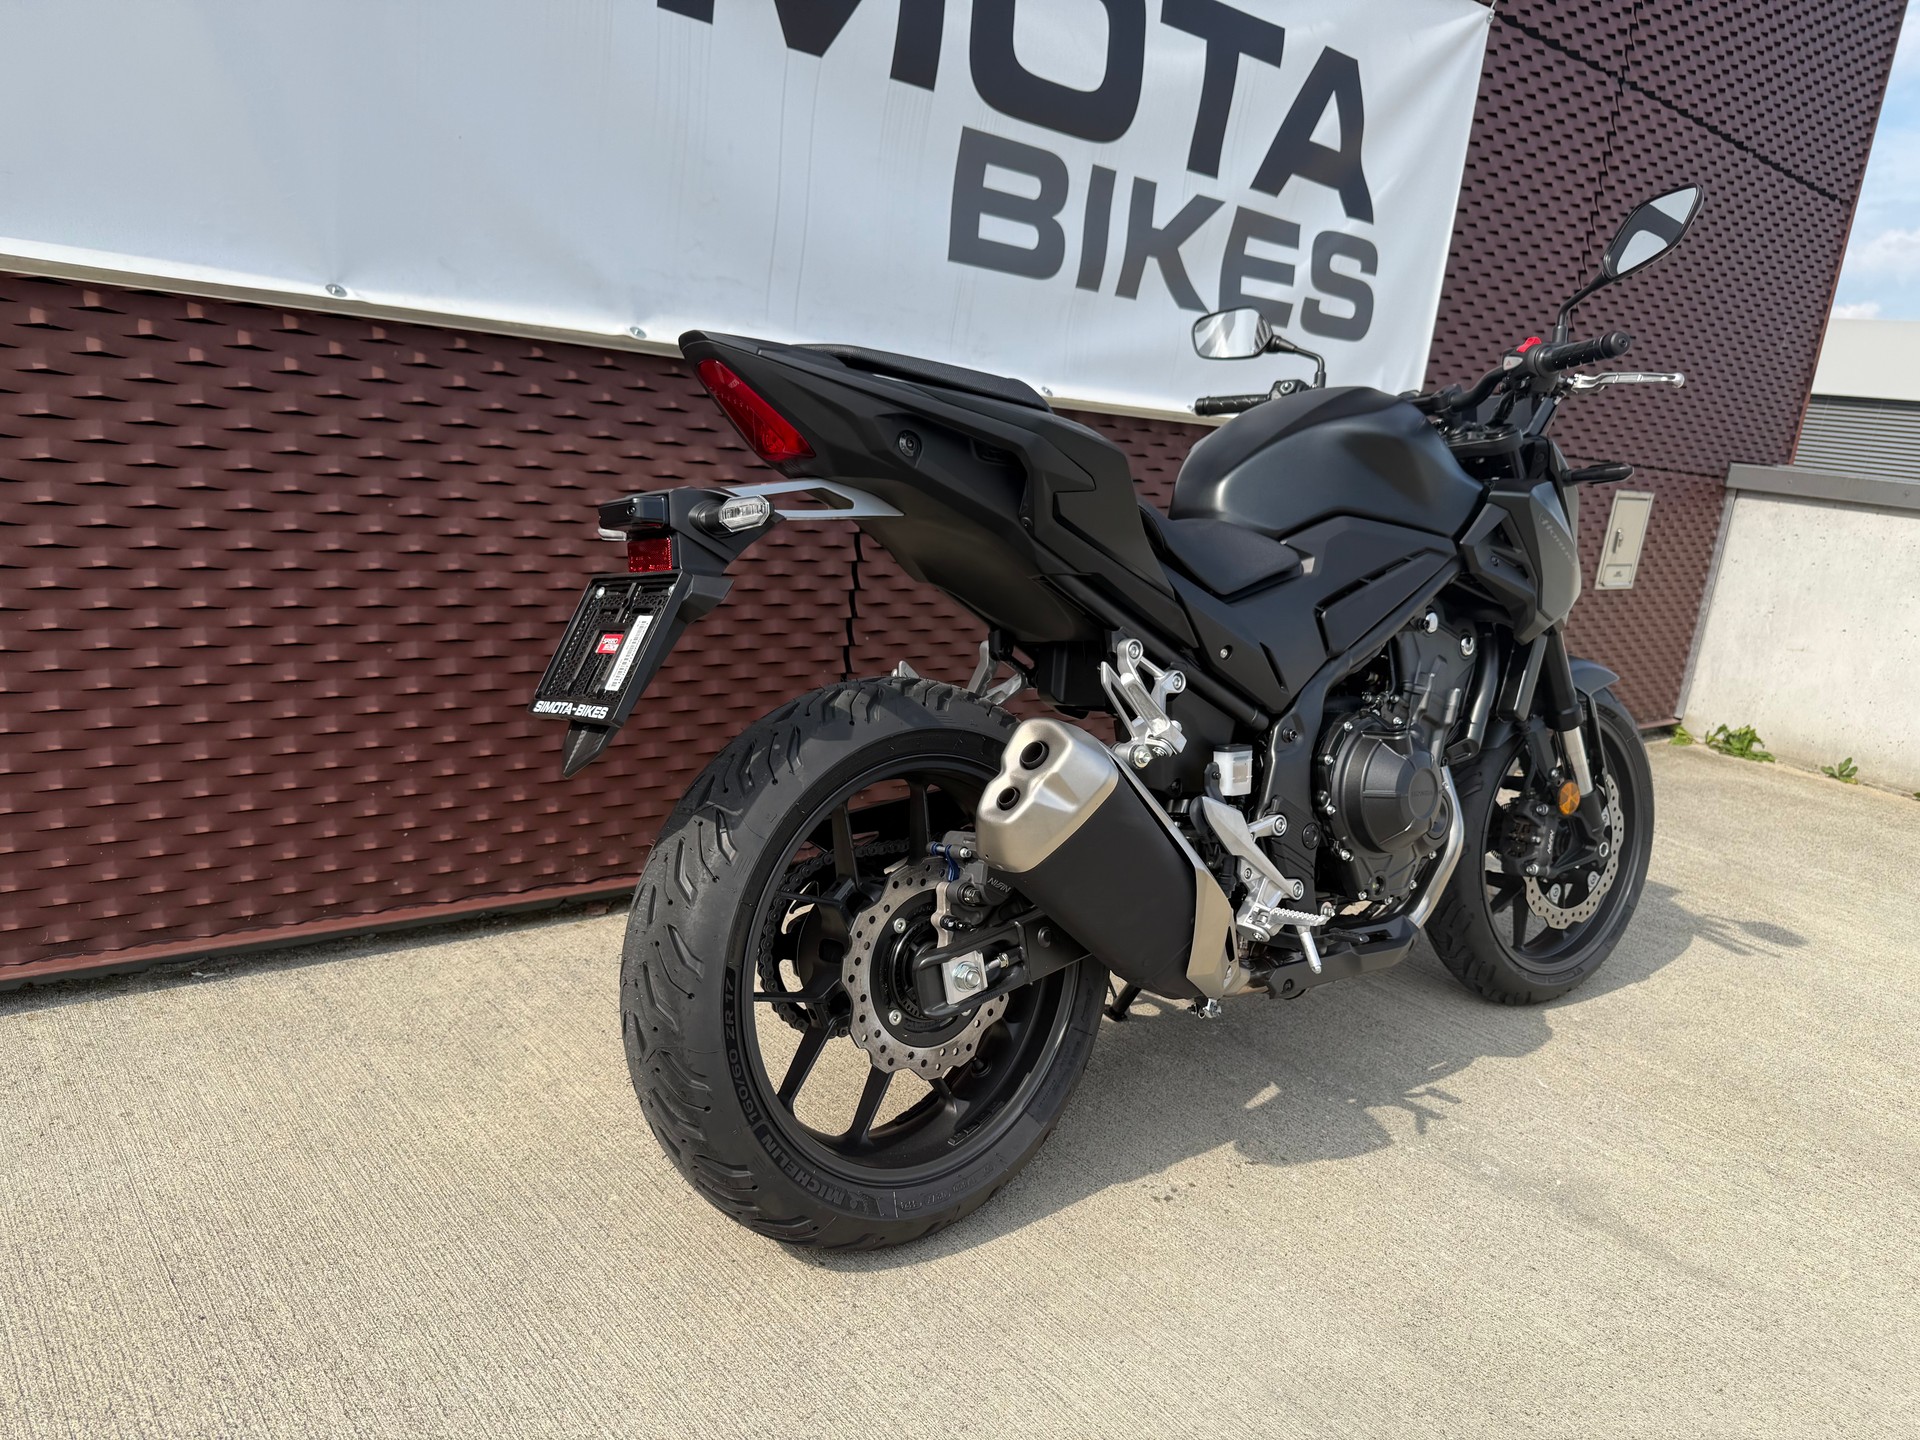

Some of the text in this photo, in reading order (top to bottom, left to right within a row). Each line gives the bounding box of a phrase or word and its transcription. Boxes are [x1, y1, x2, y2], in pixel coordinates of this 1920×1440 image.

[948, 126, 1378, 342] BIKES
[533, 701, 609, 719] SIMOTA-BIKES
[725, 977, 759, 1123] 160/60 ZR 17
[761, 1134, 846, 1206] MICHELIN
